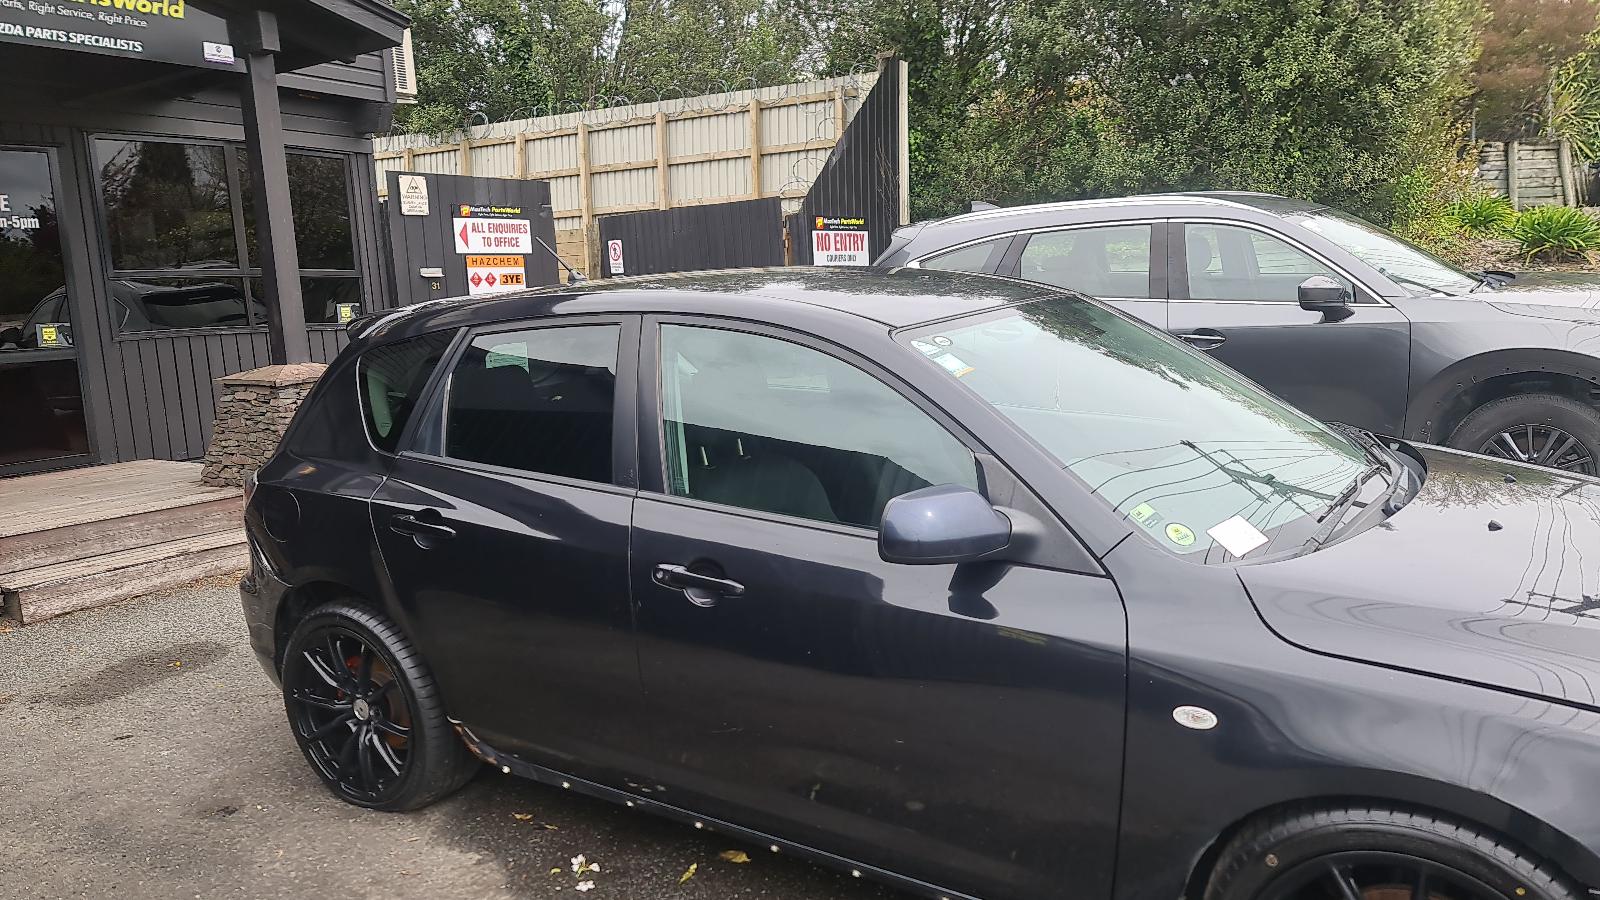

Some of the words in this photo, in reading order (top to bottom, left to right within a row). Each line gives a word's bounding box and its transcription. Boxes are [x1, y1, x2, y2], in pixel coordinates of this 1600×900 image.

[28, 1, 56, 15] Right
[98, 11, 123, 25] Right
[124, 16, 148, 27] Price
[26, 26, 67, 42] PARTS
[69, 32, 143, 52] SPECIALISTS
[471, 222, 486, 233] ALL
[488, 222, 528, 234] ENQUIRIES
[482, 236, 492, 248] TO
[494, 236, 520, 248] OFFICE
[816, 233, 831, 251] NO
[834, 233, 864, 251] ENTRY
[471, 257, 520, 266] HAZCHEM
[502, 274, 522, 284] 3YE
[431, 281, 441, 290] 31
